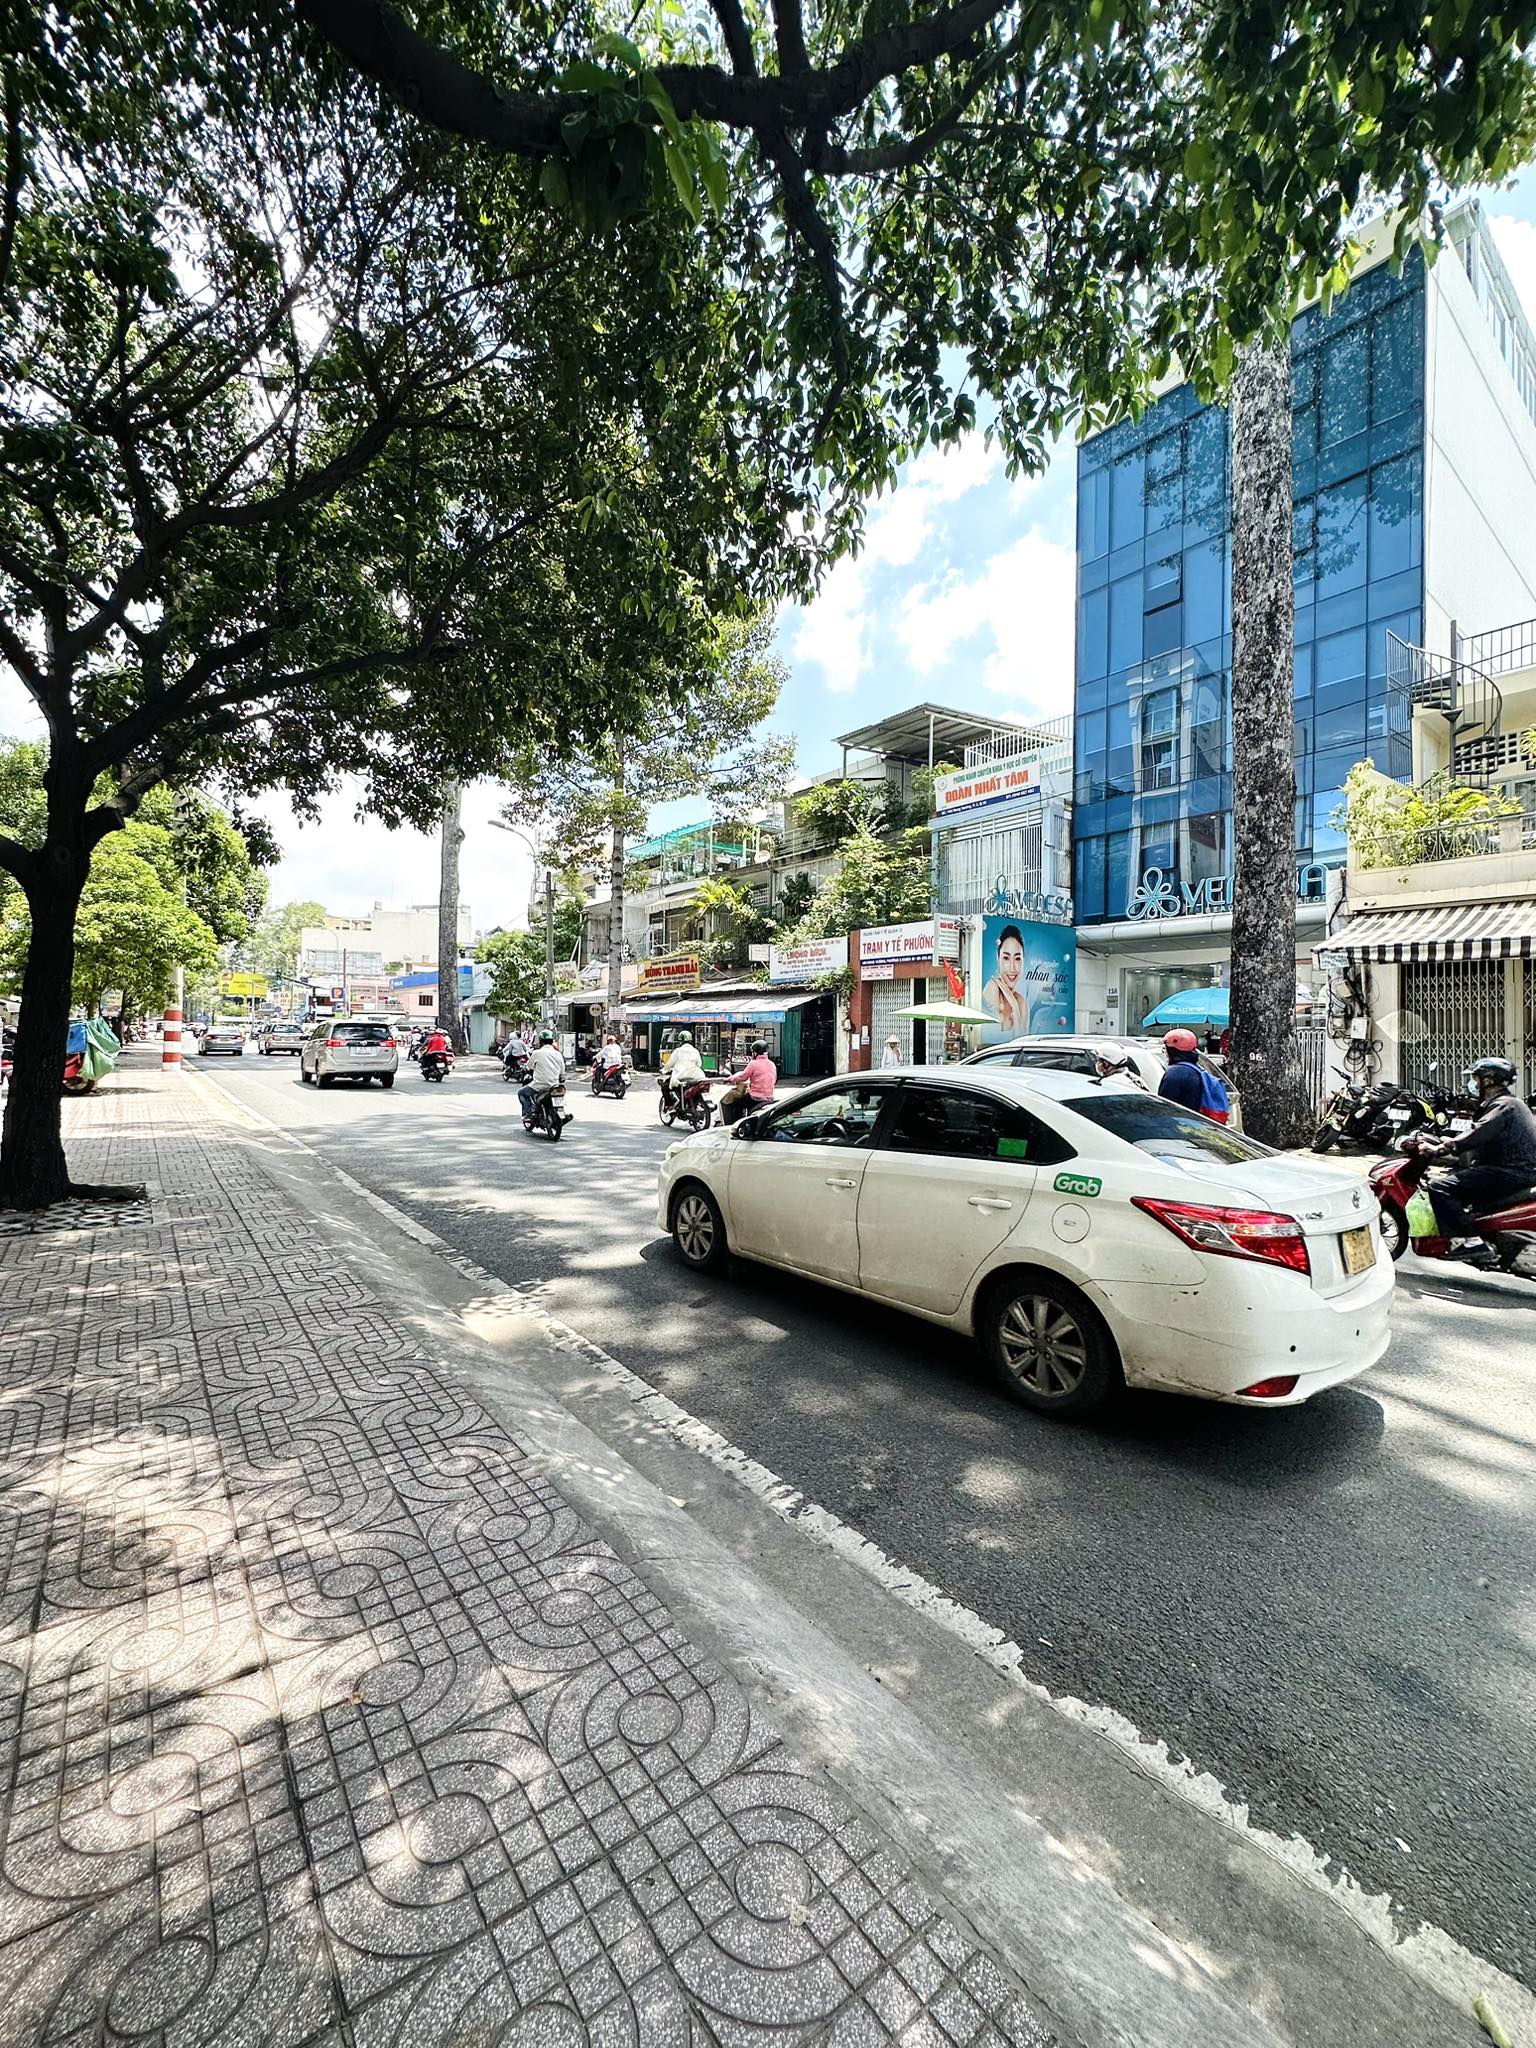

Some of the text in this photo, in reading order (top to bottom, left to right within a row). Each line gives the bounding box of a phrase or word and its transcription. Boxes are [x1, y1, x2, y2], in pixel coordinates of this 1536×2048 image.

[945, 785, 972, 804] ĐOÀN
[974, 774, 1002, 797] NHẤT
[1004, 769, 1029, 788] TÂM
[862, 942, 883, 956] TRẠM
[884, 940, 891, 952] Y
[892, 934, 903, 952] TẾ
[1025, 963, 1050, 982] nhan
[1249, 1052, 1263, 1062] 96
[1055, 1175, 1099, 1196] Grab
